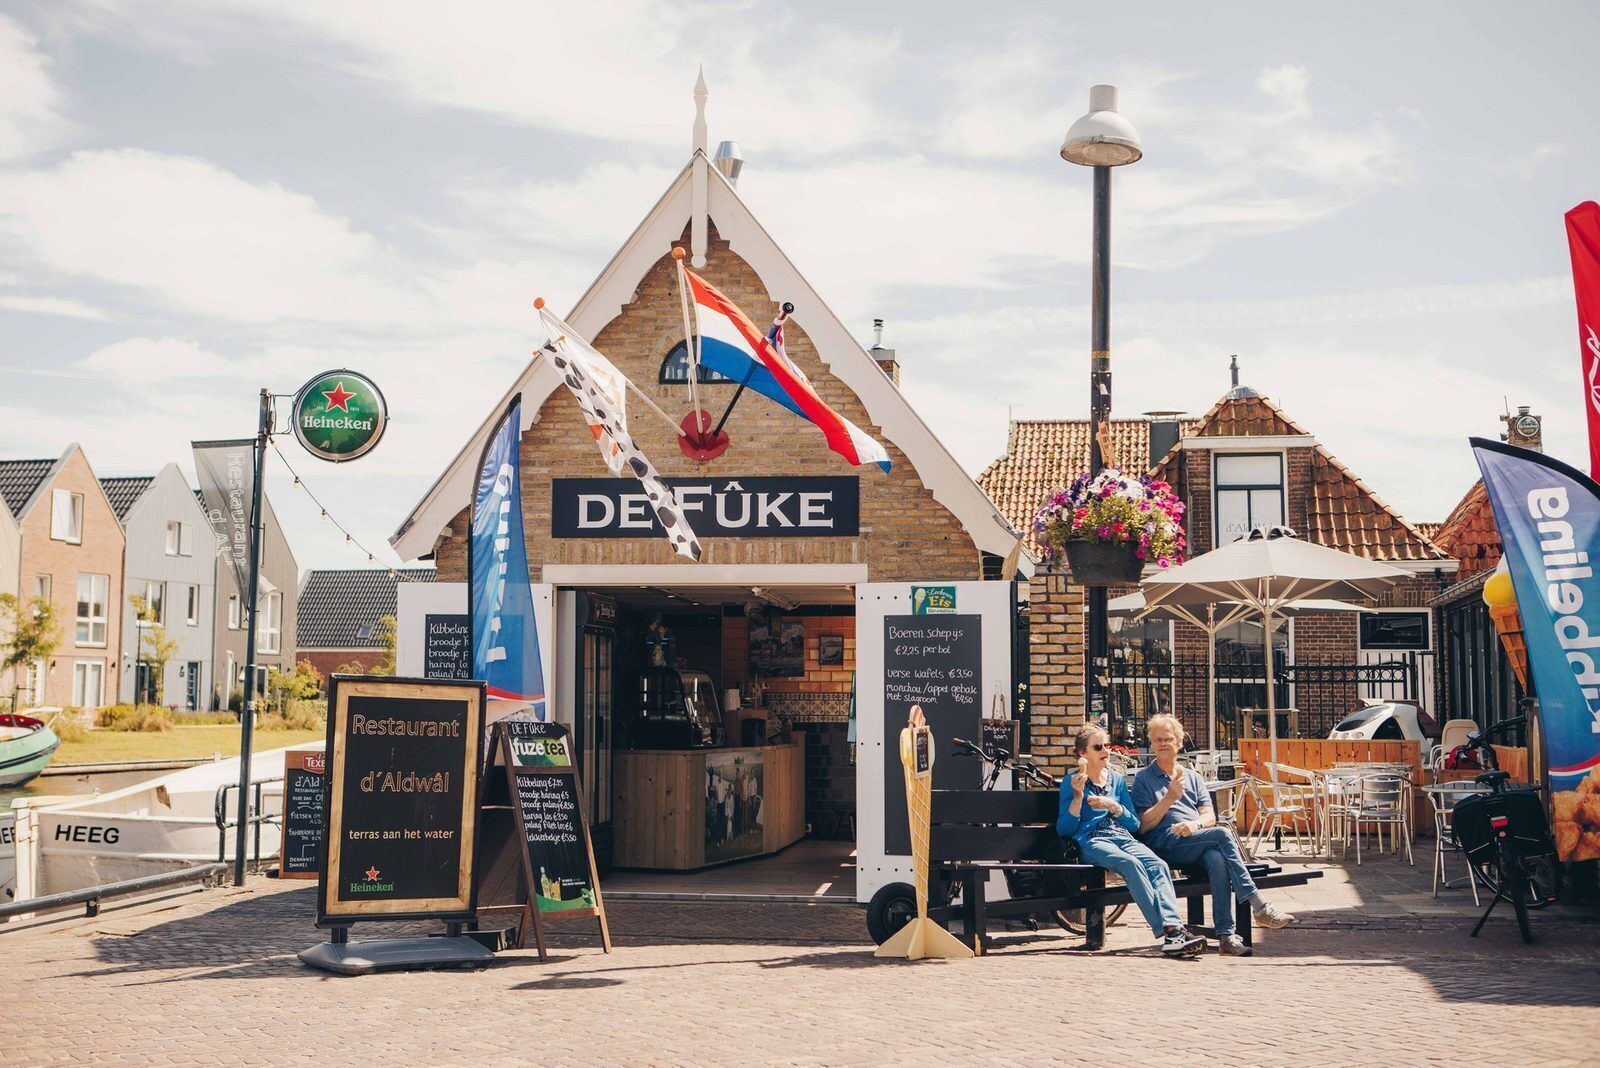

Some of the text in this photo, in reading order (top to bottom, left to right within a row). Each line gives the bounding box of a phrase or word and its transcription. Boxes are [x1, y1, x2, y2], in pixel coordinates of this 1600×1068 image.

[303, 416, 371, 430] Heineken
[227, 452, 247, 567] Restaurant
[577, 481, 834, 529] DE FÛKE
[928, 595, 952, 608] Eis
[888, 626, 924, 640] Boeren
[429, 636, 462, 649] broodje
[428, 648, 460, 660] broodje
[922, 645, 936, 657] per
[937, 645, 951, 654] bol
[428, 660, 456, 672] haring
[886, 668, 911, 678] verse
[914, 667, 944, 679] wafels
[950, 684, 978, 698] gebak
[903, 693, 939, 705] slagroom
[352, 714, 460, 738] Restaurant
[511, 723, 523, 735] DE
[512, 737, 567, 756] fuzetea
[516, 775, 549, 791] Kibbeling
[518, 789, 540, 802] broodje
[521, 799, 541, 811] broodje
[522, 810, 543, 823] haring
[525, 821, 543, 832] paling
[54, 824, 120, 844] HEEG
[349, 829, 454, 840] terras aan het water
[350, 882, 394, 893] Heineken
